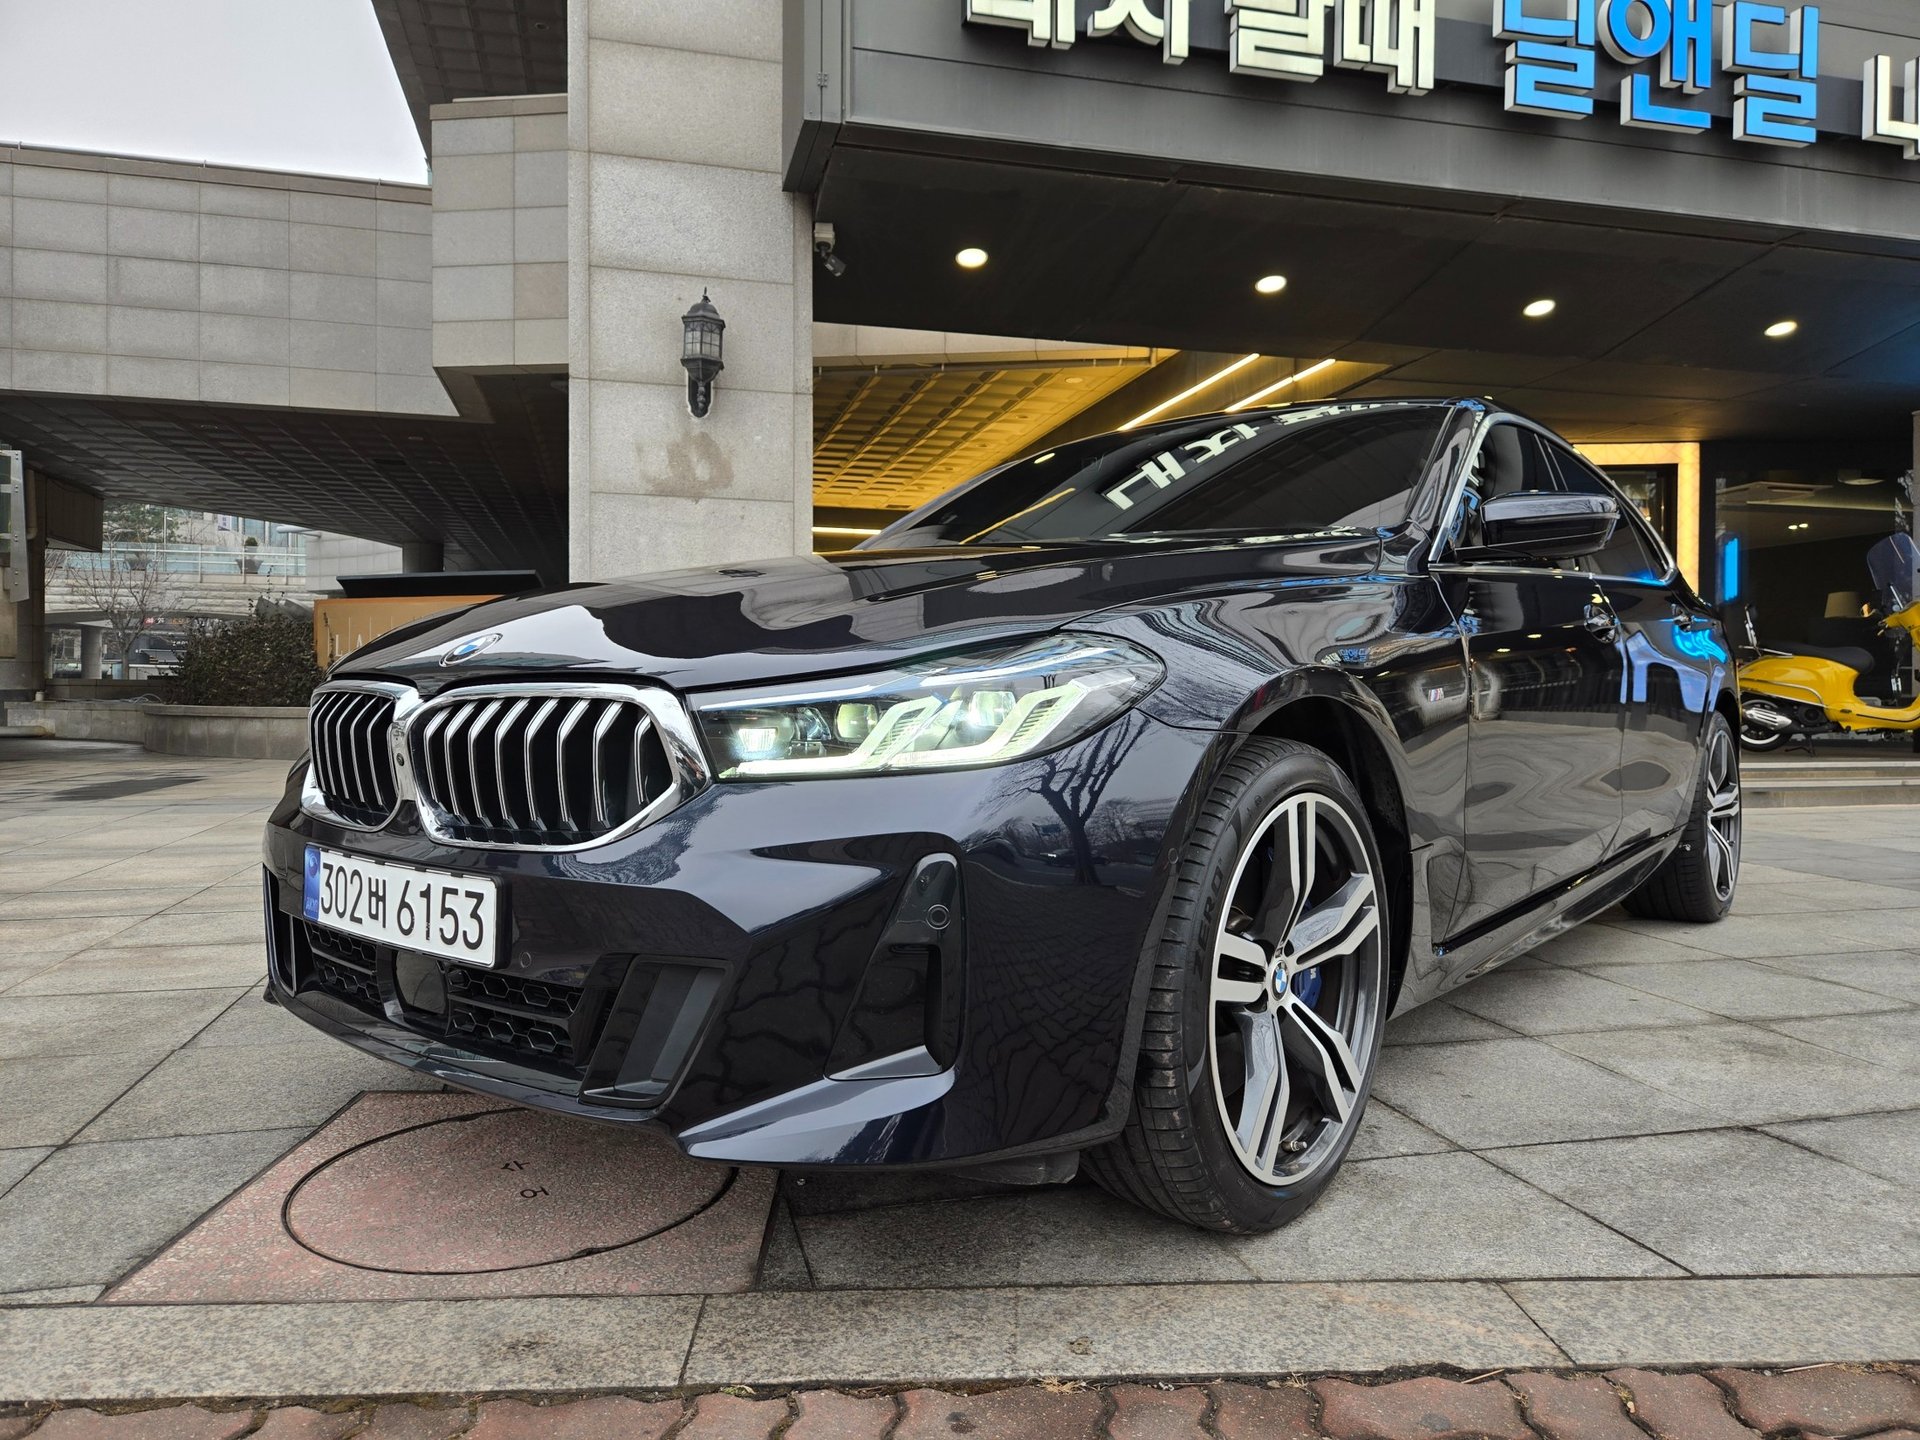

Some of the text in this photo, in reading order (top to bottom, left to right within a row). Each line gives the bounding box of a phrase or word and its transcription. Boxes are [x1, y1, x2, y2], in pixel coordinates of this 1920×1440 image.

[1494, 0, 1819, 147] 딜앤딜
[321, 862, 485, 951] 302버 6153
